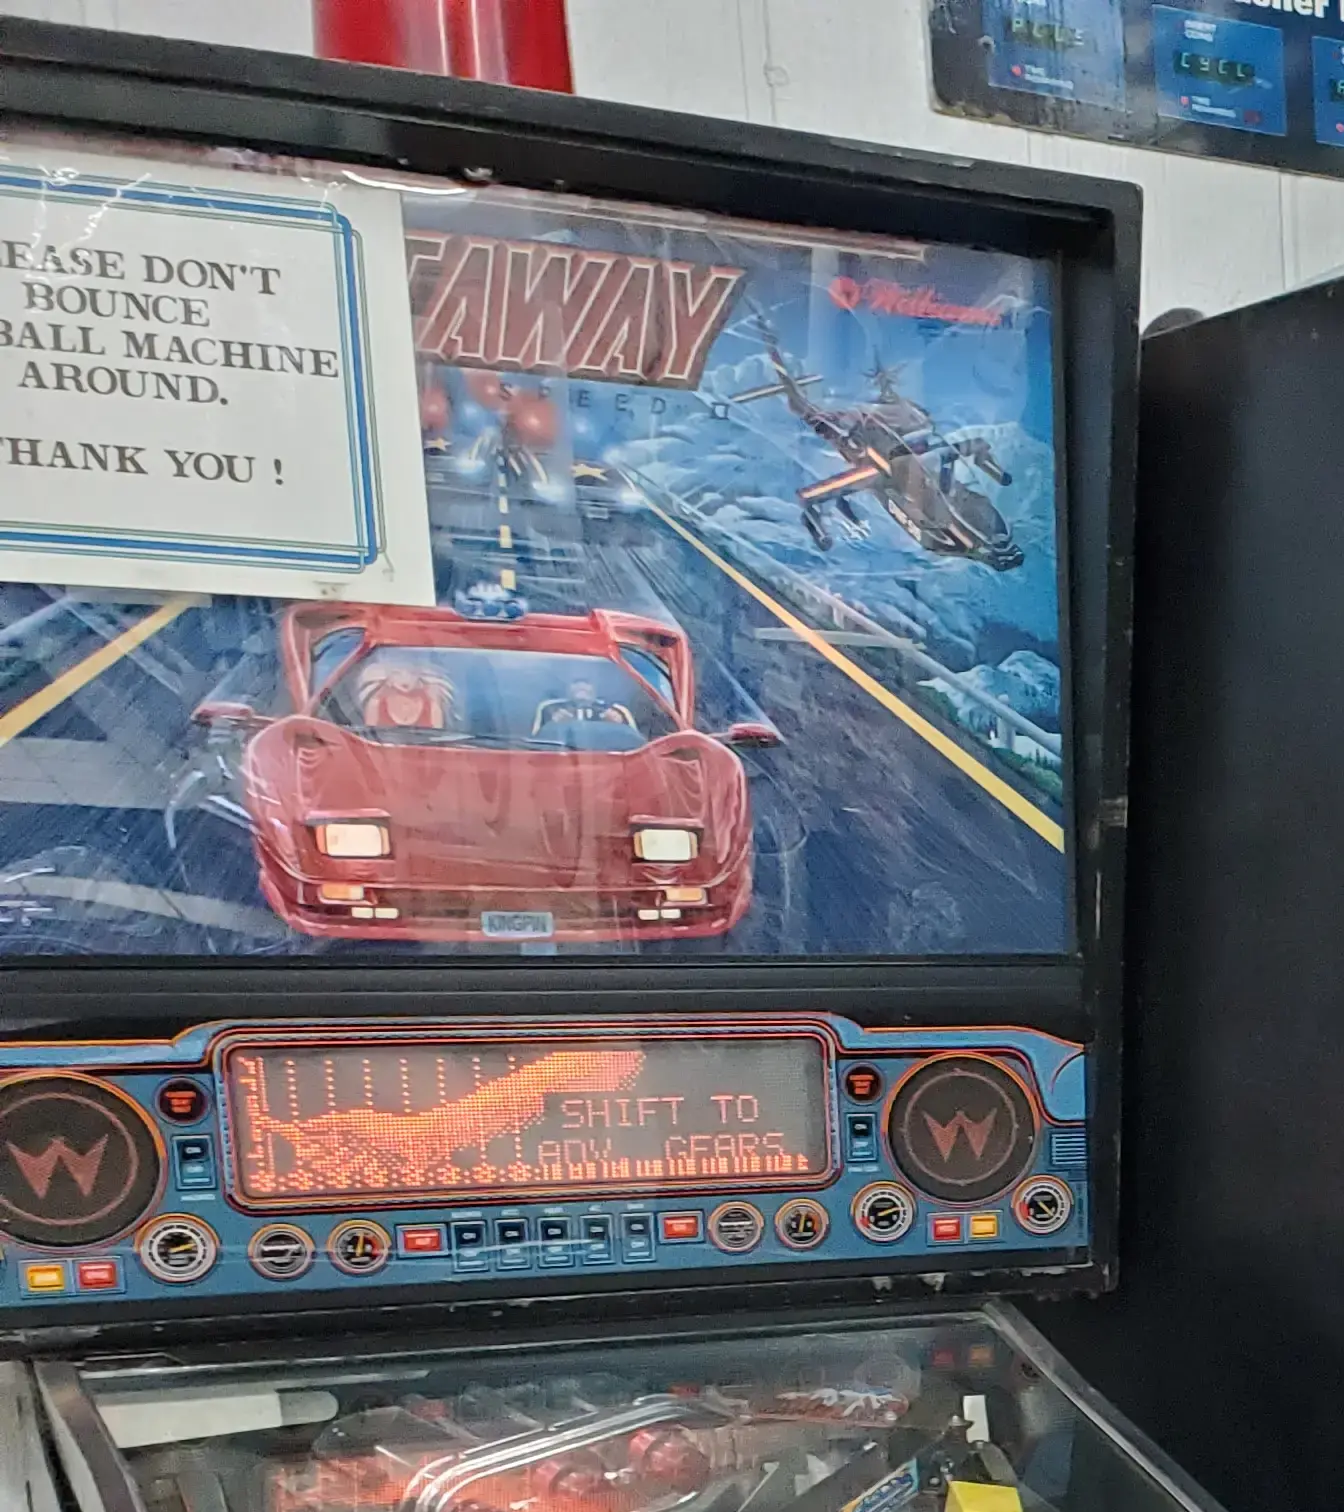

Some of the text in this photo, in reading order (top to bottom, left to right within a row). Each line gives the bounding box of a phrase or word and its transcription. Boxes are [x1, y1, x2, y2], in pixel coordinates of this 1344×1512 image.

[0, 239, 281, 296] EASE DON'T
[21, 280, 210, 328] BOUNCE
[121, 329, 340, 380] MACHINE
[17, 360, 229, 406] AROUND.
[0, 436, 148, 475] HANK
[164, 448, 256, 484] YOU
[487, 914, 547, 933] KINGPIN
[560, 1093, 761, 1130] SHIFT TO
